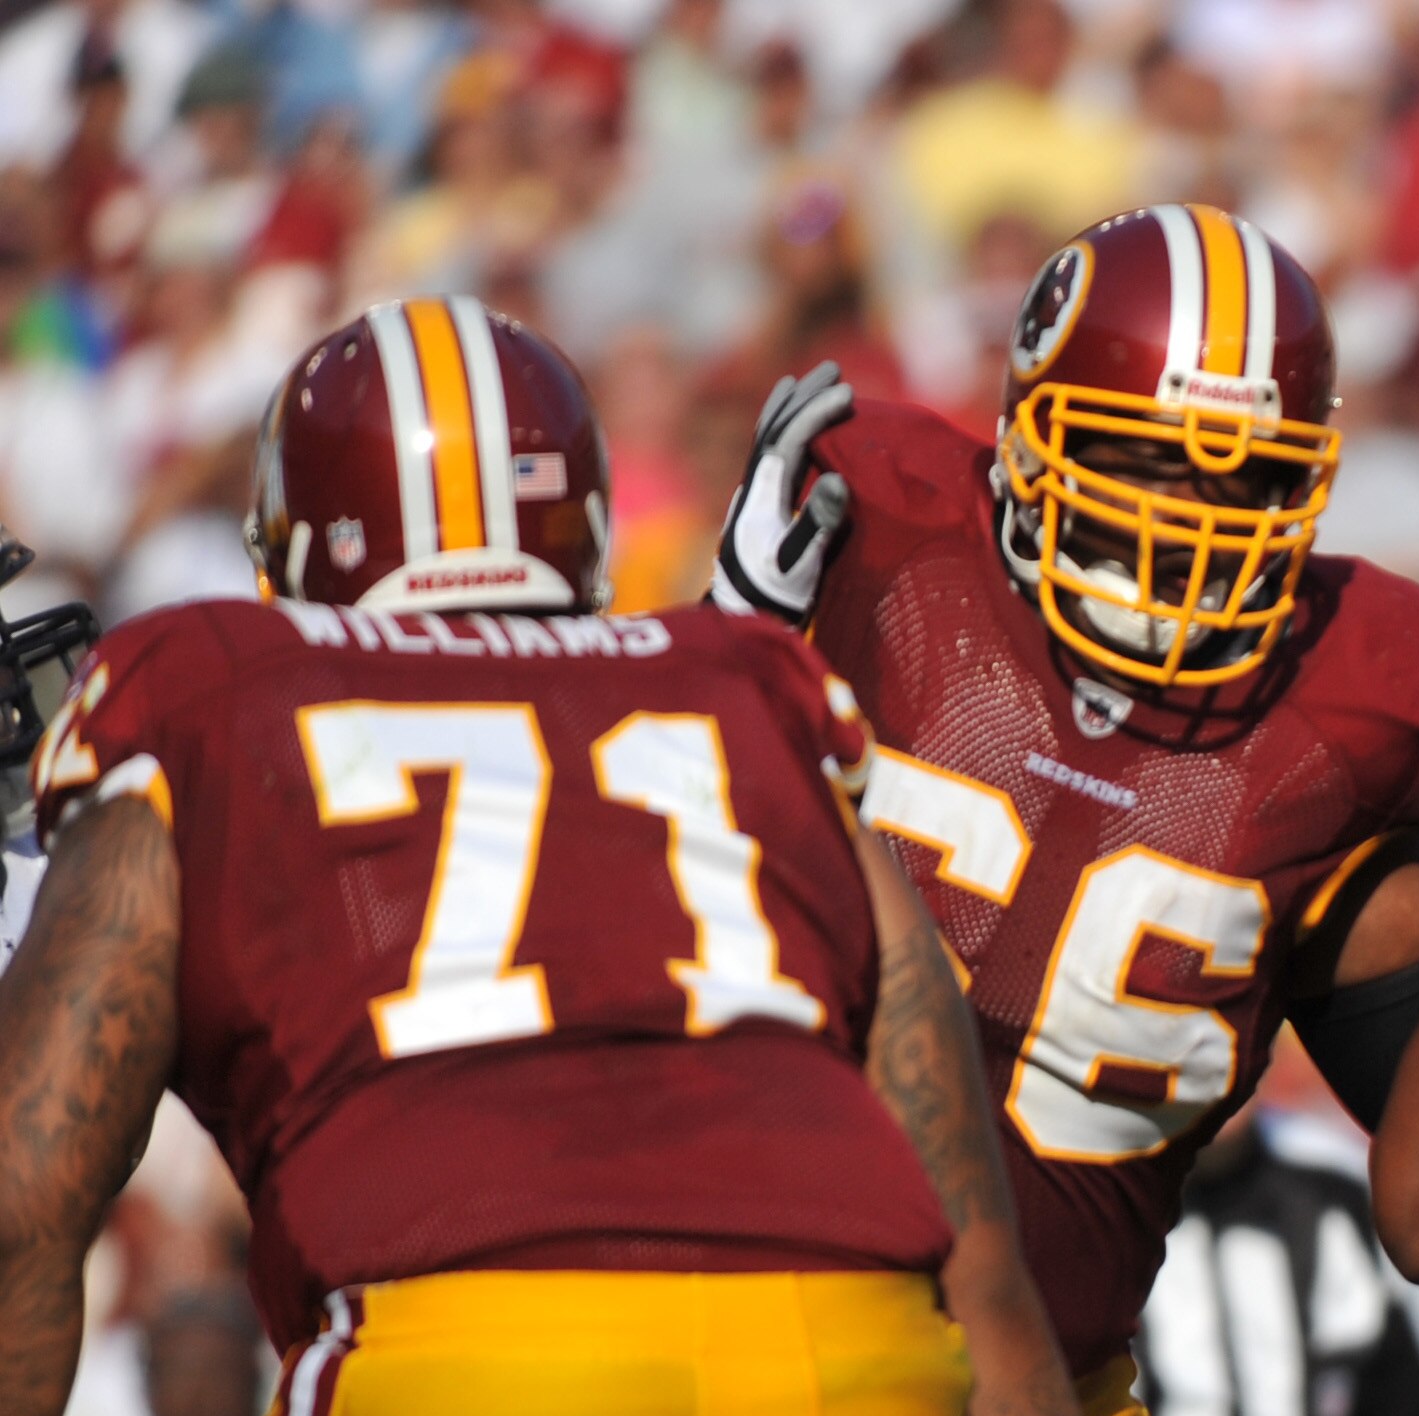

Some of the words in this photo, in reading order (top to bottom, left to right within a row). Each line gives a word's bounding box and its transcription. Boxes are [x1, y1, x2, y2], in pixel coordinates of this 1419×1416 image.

[276, 602, 673, 658] WILLIAMS
[1025, 751, 1138, 809] REDSKINS
[294, 698, 828, 1060] 71
